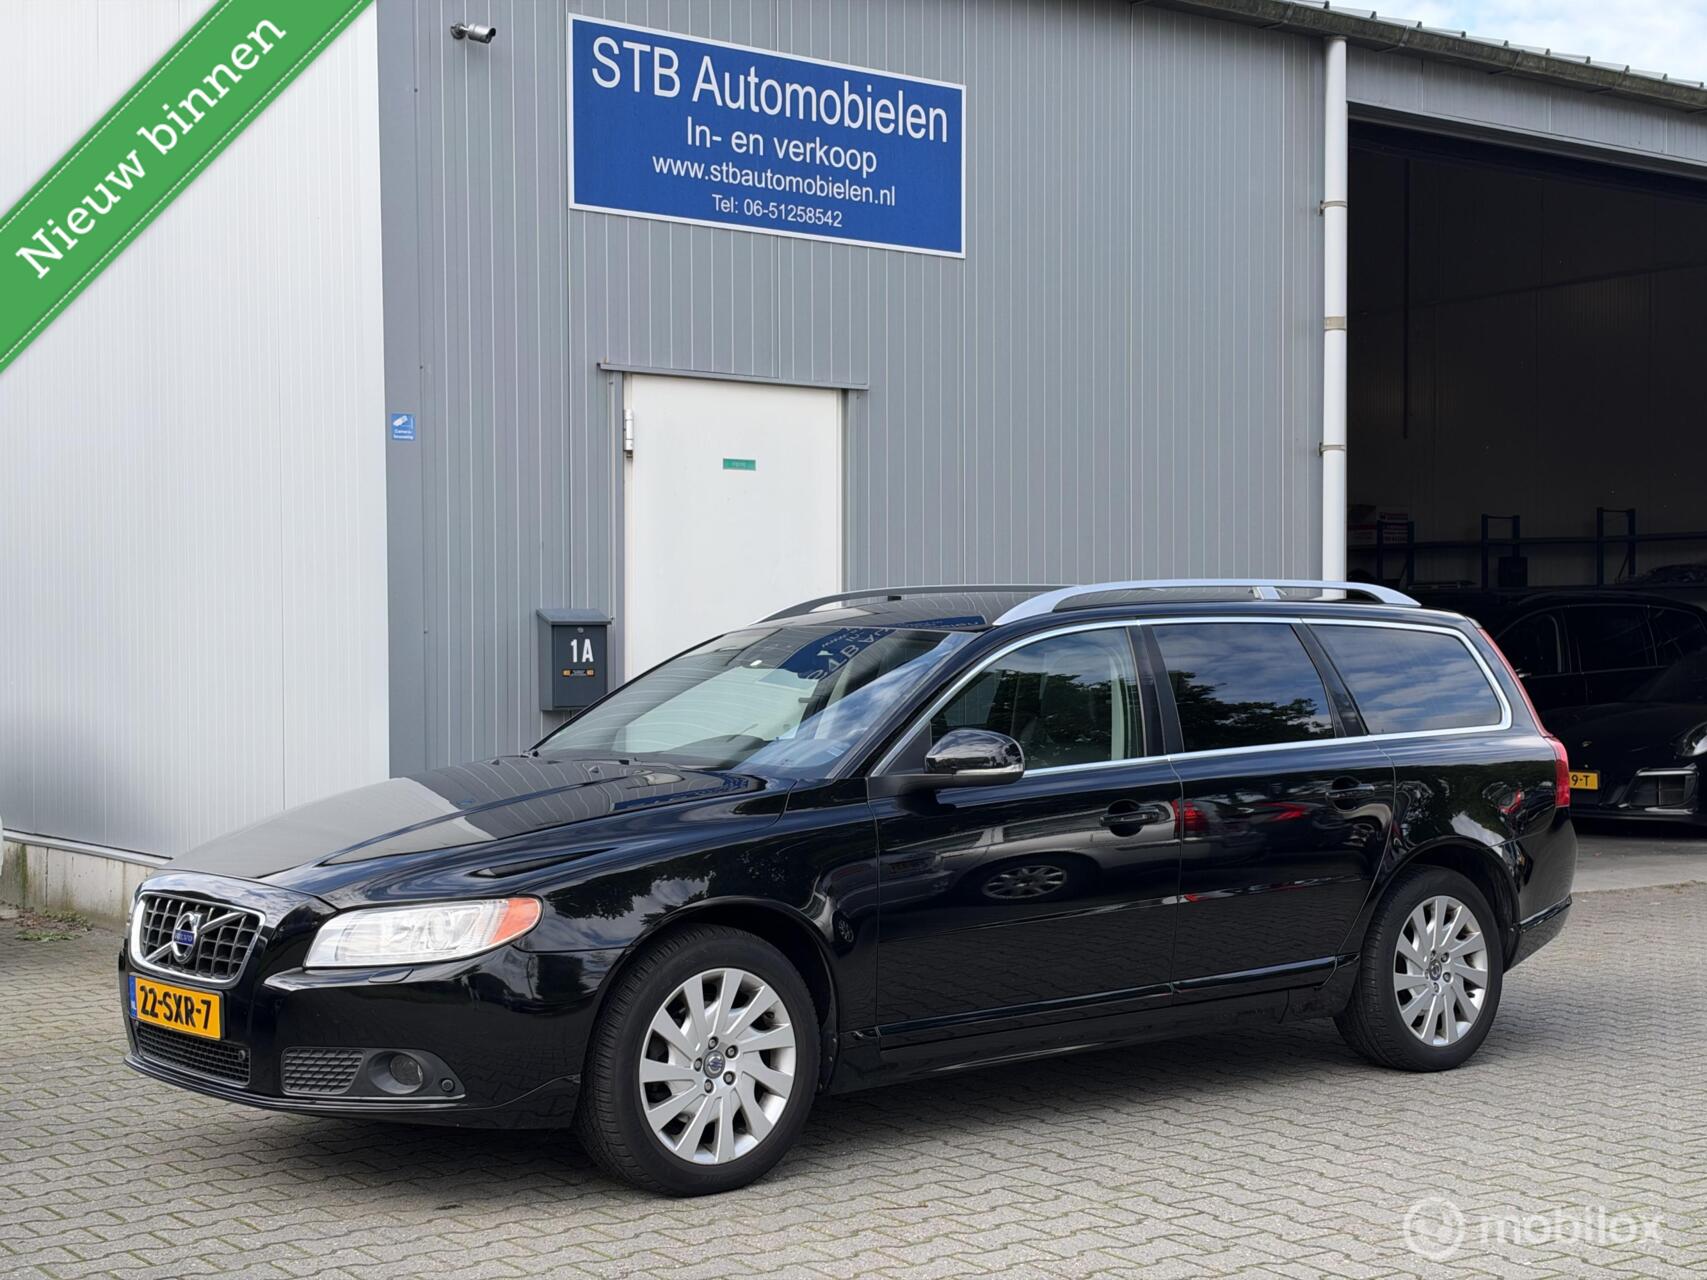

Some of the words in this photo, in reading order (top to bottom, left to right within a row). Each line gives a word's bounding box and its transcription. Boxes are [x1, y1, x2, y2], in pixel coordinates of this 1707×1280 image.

[592, 37, 681, 98] STB
[692, 56, 948, 142] Automobielen
[687, 117, 722, 147] In-
[732, 132, 763, 156] en
[774, 137, 877, 177] verkoop
[652, 157, 895, 206] www.stbautomobielen.nl
[712, 194, 739, 214] Tel:
[744, 198, 842, 227] 06-51258542
[570, 639, 594, 663] 1A
[140, 985, 212, 1030] 22-SXR-7
